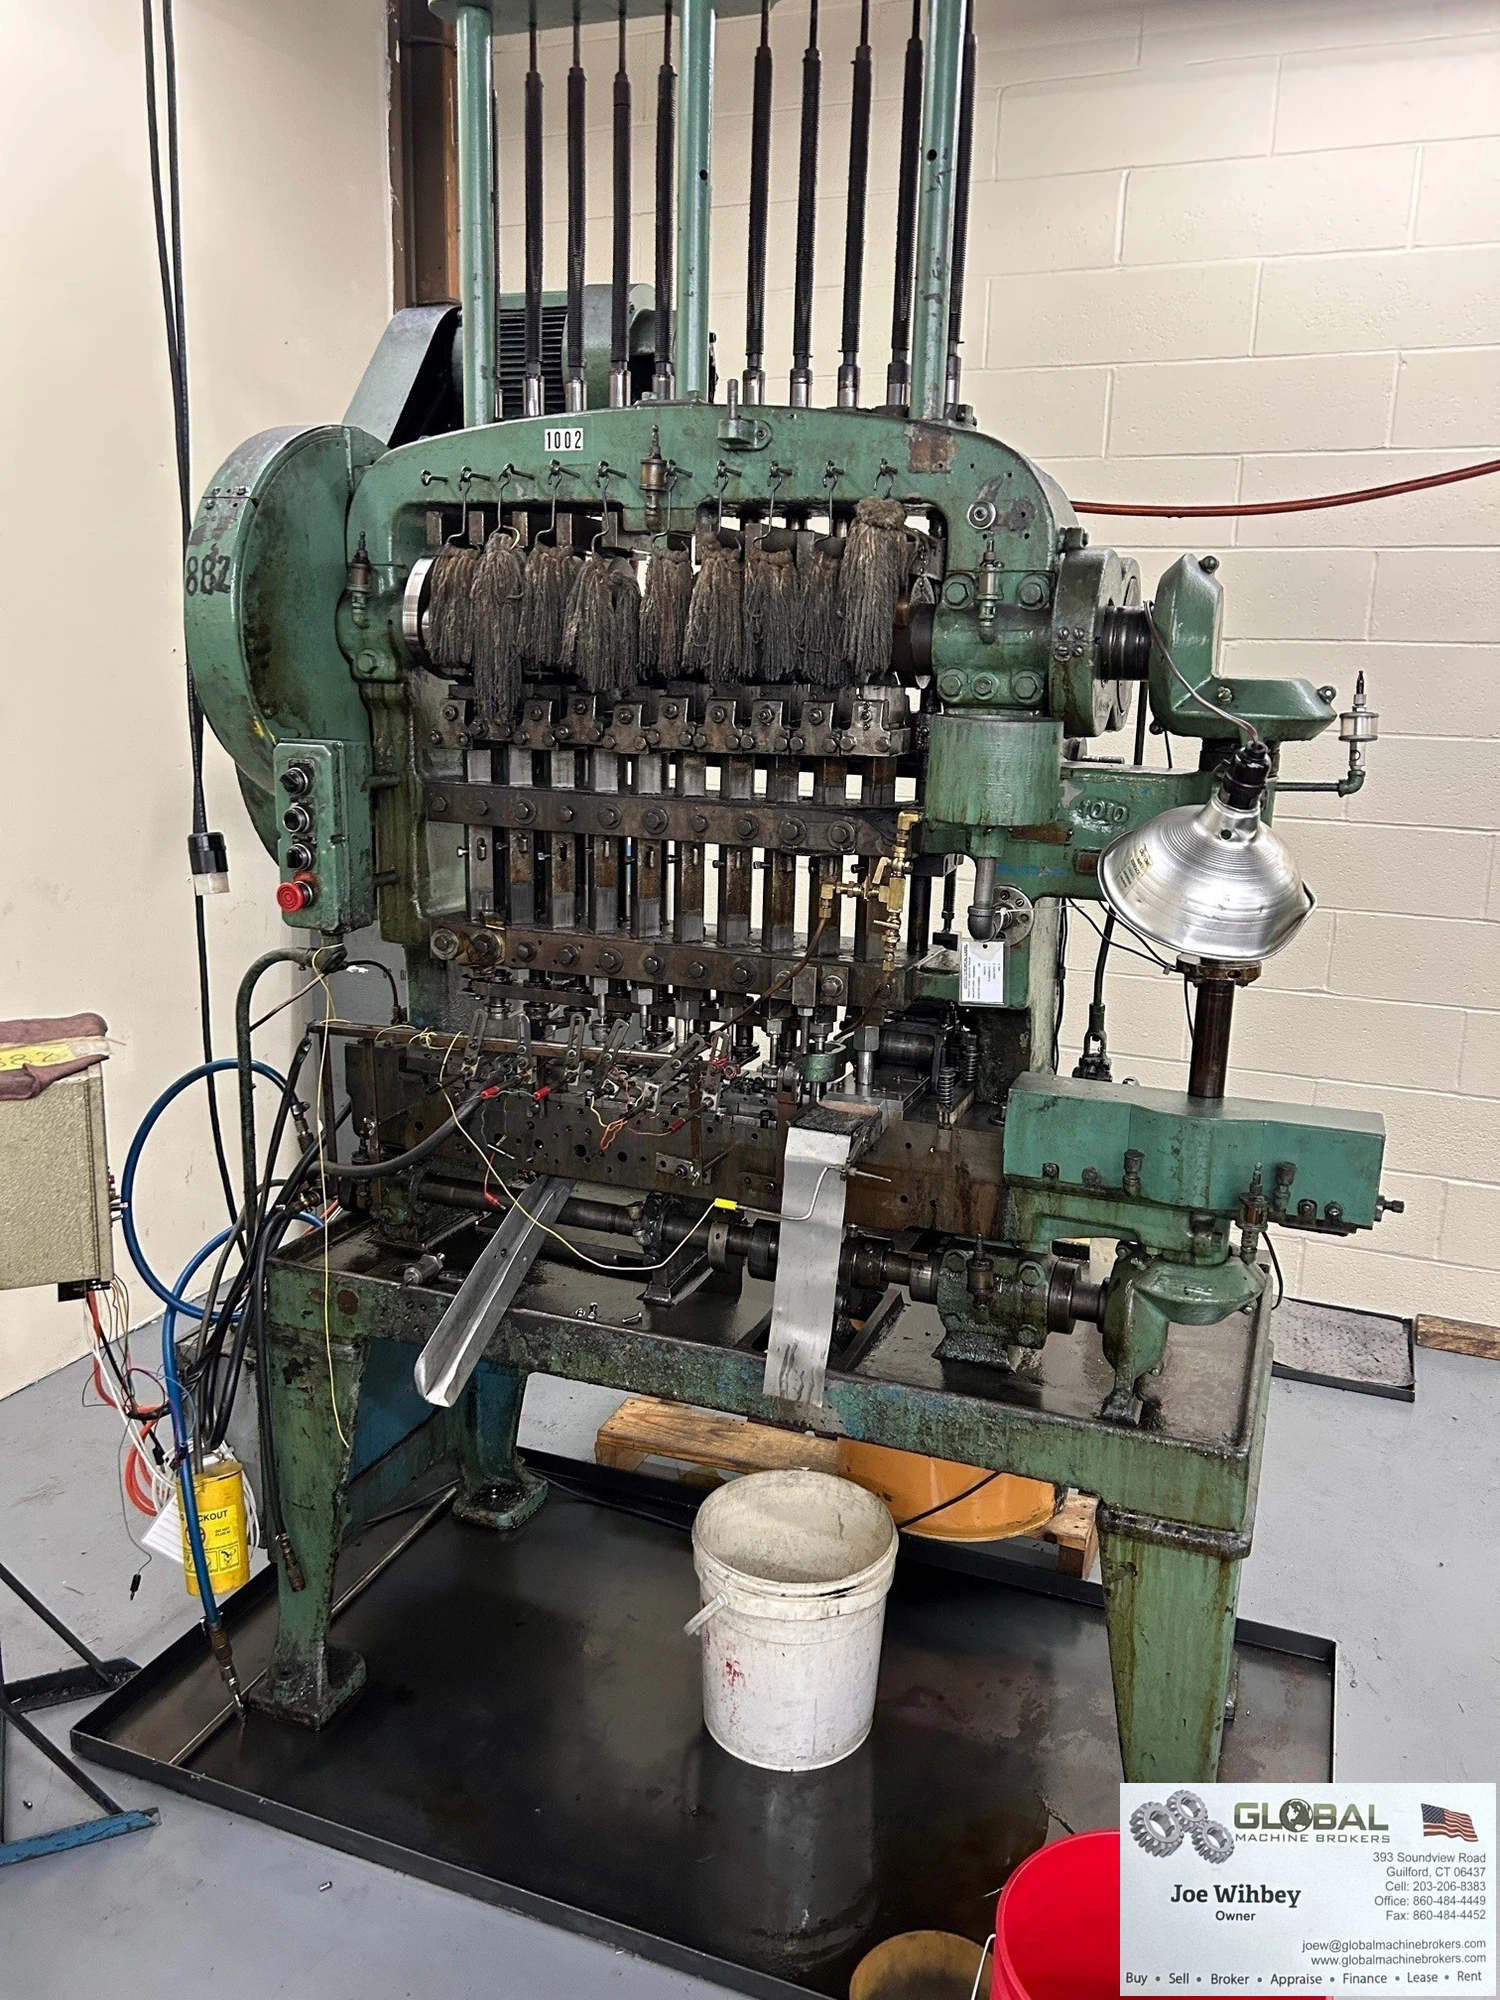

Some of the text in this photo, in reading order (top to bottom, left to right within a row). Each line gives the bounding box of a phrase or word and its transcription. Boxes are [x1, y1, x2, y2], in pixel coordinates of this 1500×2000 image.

[546, 430, 582, 450] 1002
[186, 554, 231, 597] 882
[198, 1509, 228, 1523] CKOUT
